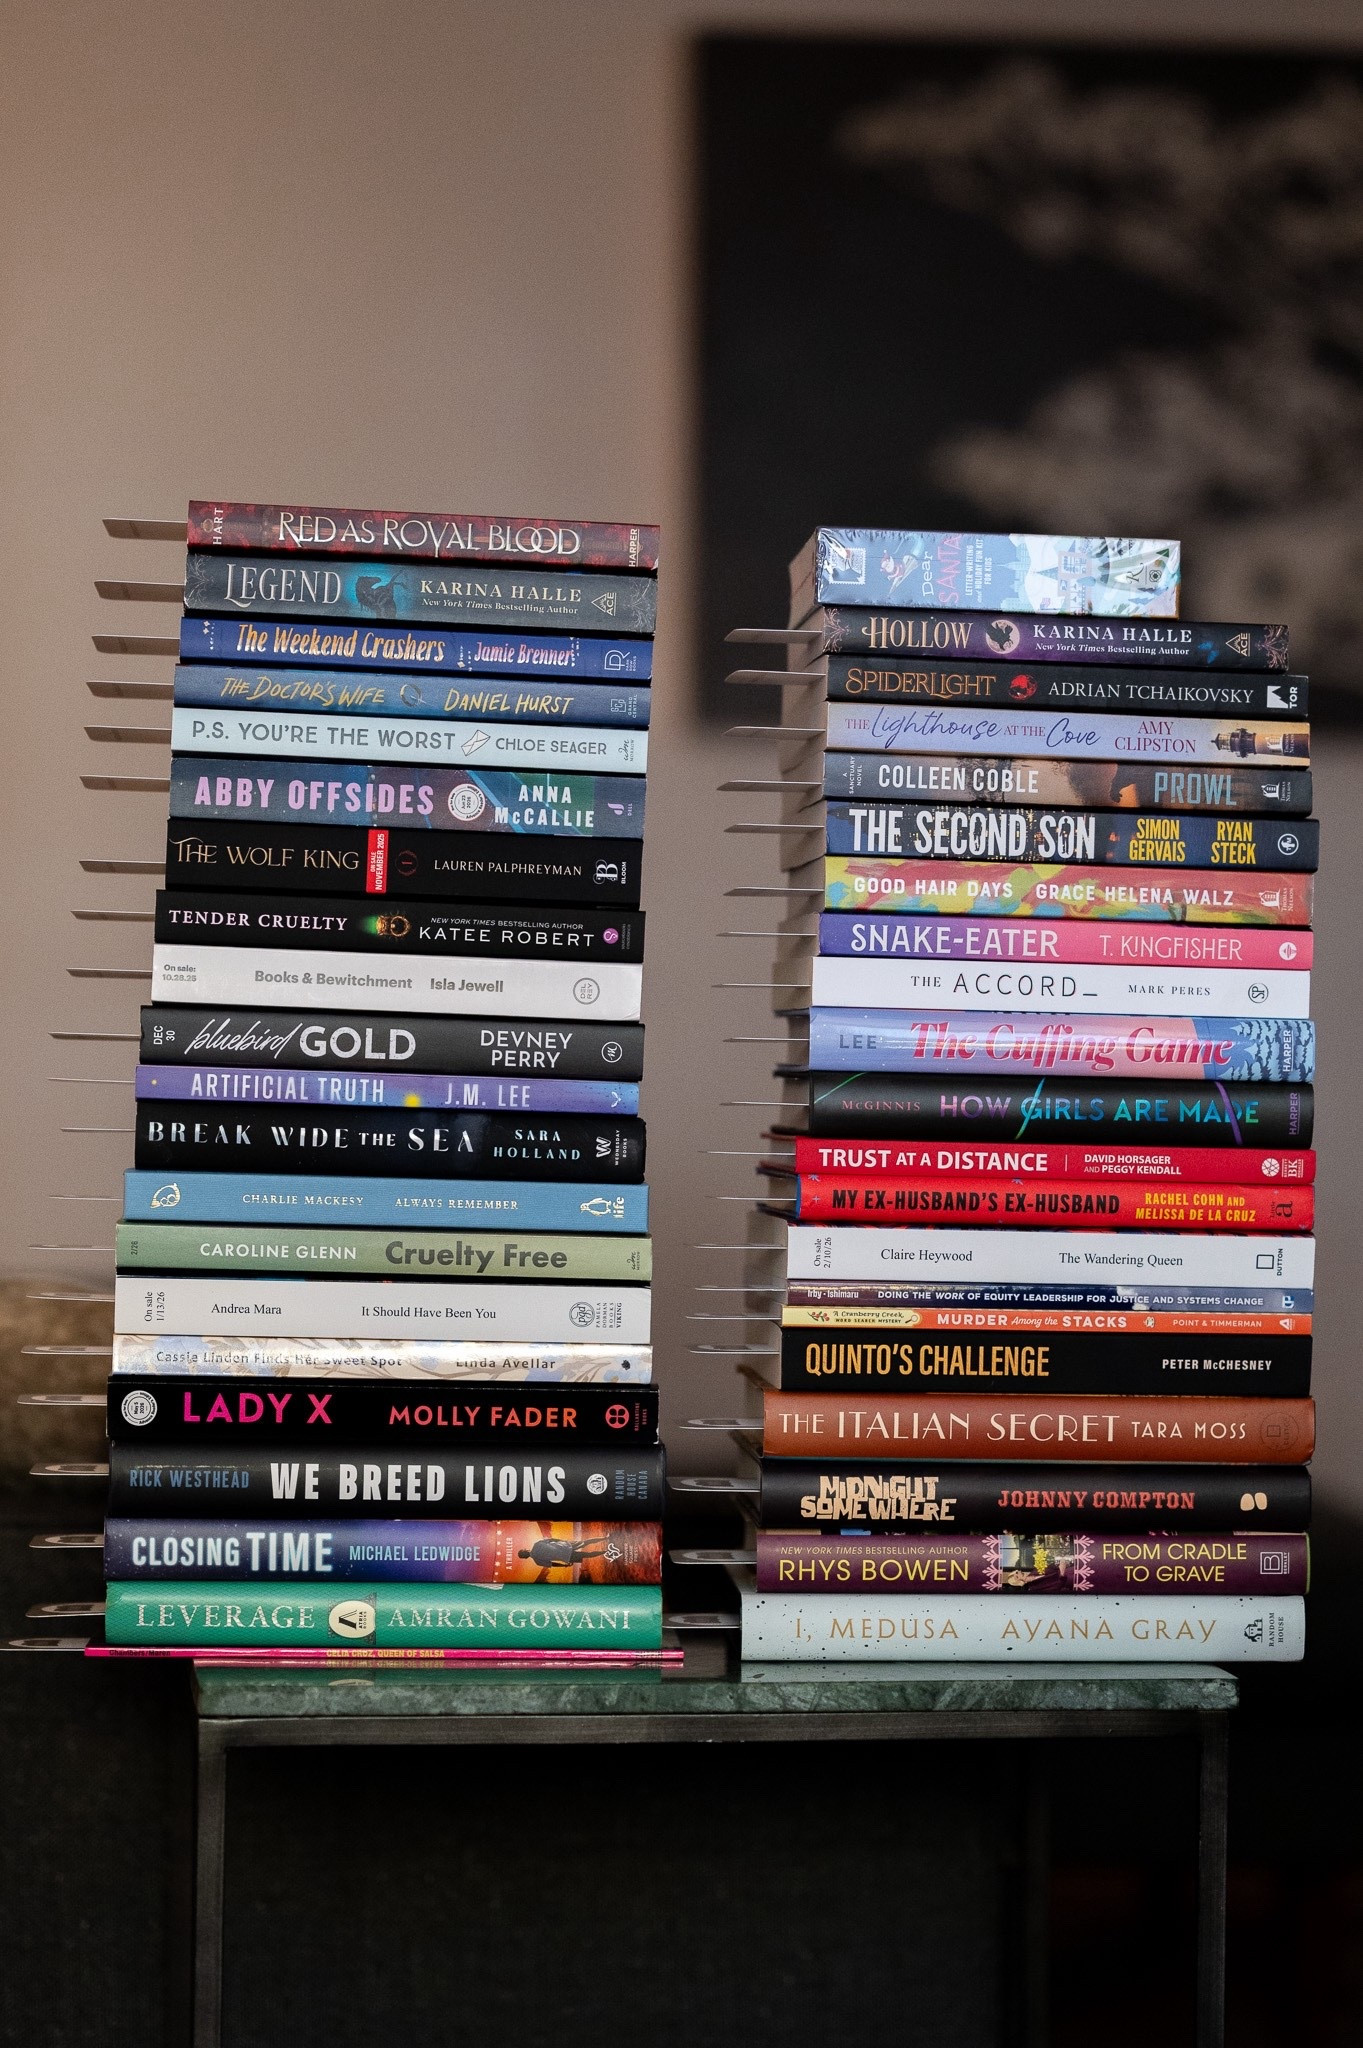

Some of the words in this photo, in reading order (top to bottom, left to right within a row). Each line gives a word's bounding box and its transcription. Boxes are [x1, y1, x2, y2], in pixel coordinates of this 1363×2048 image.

[212, 508, 224, 545] HART
[278, 512, 336, 547] RED
[341, 520, 376, 543] AS
[383, 518, 481, 558] ROYAL
[488, 524, 580, 554] BLOOD
[224, 563, 342, 608] LEGEND
[420, 580, 502, 598] KARINA
[511, 586, 581, 602] HALLE
[422, 598, 440, 606] New
[443, 600, 463, 608] York
[466, 600, 492, 610] Times
[495, 602, 544, 614] Bestselling
[547, 606, 578, 614] Author
[236, 624, 268, 652] The
[274, 627, 358, 656] Weekend
[362, 632, 446, 662] Crashers
[862, 616, 973, 648] HOLLOW
[474, 642, 514, 663] Jamie
[518, 644, 572, 666] Brenner
[1056, 644, 1076, 652] York
[1078, 644, 1105, 652] Times
[1108, 646, 1156, 656] Bestselling
[1158, 647, 1190, 655] Author
[846, 668, 996, 699] SPIDERLIGHT
[1048, 682, 1120, 698] ADRIAN
[1126, 684, 1254, 704] TCHAIKOVSKY
[192, 720, 229, 739] P.S.
[238, 722, 318, 744] YOU'RE
[327, 727, 368, 746] THE
[378, 730, 456, 750] WORST
[194, 776, 274, 808] ABBY
[288, 780, 434, 815] OFFSIDES
[1154, 772, 1236, 806] PROWL
[849, 808, 903, 852] THE
[915, 811, 1026, 857] SECOND
[1038, 816, 1095, 860] SON
[169, 837, 217, 864] THE
[226, 846, 294, 867] WOLF
[304, 850, 359, 870] KING
[854, 878, 905, 894] GOOD
[916, 880, 957, 896] HAIR
[968, 881, 1012, 897] DAYS
[1036, 884, 1094, 900] GRACE
[1106, 886, 1174, 904] HELENA
[1184, 890, 1234, 906] WALZ
[168, 910, 250, 926] TENDER
[258, 914, 348, 930] CRUELTY
[851, 924, 1060, 957] SNAKE-EATER
[255, 970, 298, 984] Books
[302, 974, 312, 984] &
[316, 974, 412, 989] Bewitchment
[910, 976, 941, 988] THE
[1128, 984, 1164, 994] MARK
[1171, 986, 1210, 996] PERES
[184, 1018, 303, 1059] bluebird
[300, 1026, 416, 1060] GOLD
[191, 1074, 308, 1100] ARTIFICIAL
[318, 1078, 384, 1102] TRUTH
[940, 1096, 1011, 1118] HOW
[1020, 1097, 1104, 1121] GIRLS
[1114, 1099, 1168, 1122] ARE
[1179, 1100, 1259, 1123] MADE
[148, 1121, 251, 1144] BREAK
[271, 1126, 348, 1148] WIDE
[358, 1132, 396, 1146] THE
[407, 1128, 474, 1152] SEA
[818, 1148, 891, 1168] TRUST
[896, 1152, 916, 1166] AT
[920, 1153, 932, 1166] A
[937, 1152, 1048, 1172] DISTANCE
[1084, 1154, 1115, 1164] DAVID
[1117, 1156, 1171, 1164] HORSAGER
[1102, 1165, 1134, 1174] PEGGY
[1137, 1166, 1182, 1175] KENDALL
[242, 1194, 298, 1204] CHARLIE
[304, 1196, 364, 1206] MACKESY
[394, 1198, 443, 1208] ALWAYS
[448, 1200, 518, 1210] REMEMBER
[832, 1190, 858, 1208] MY
[864, 1190, 998, 1212] EX-HUSBAND'S
[1005, 1193, 1120, 1214] EX-HUSBAND
[1145, 1193, 1188, 1206] RACHEL
[1193, 1194, 1224, 1206] COHN
[1227, 1197, 1245, 1206] AND
[1135, 1208, 1184, 1220] MELISSA
[1190, 1210, 1204, 1220] DE
[1208, 1210, 1222, 1221] LA
[1226, 1210, 1256, 1222] CRUZ
[200, 1244, 289, 1258] CAROLINE
[296, 1246, 356, 1260] GLENN
[385, 1241, 494, 1273] Cruelty
[504, 1244, 568, 1268] Free
[880, 1249, 916, 1260] Claire
[919, 1250, 972, 1264] Heywood
[1059, 1253, 1080, 1264] The
[1084, 1254, 1144, 1266] Wandering
[1147, 1255, 1183, 1266] Queen
[211, 1304, 250, 1314] Andrea
[254, 1304, 282, 1315] Mara
[878, 1291, 909, 1299] DOING
[936, 1292, 965, 1300] WORK
[968, 1292, 981, 1300] OF
[984, 1293, 1020, 1301] EQUITY
[1024, 1294, 1084, 1302] LEADERSHIP
[1087, 1294, 1106, 1303] FOR
[1110, 1296, 1149, 1304] JUSTICE
[1153, 1296, 1173, 1304] AND
[1177, 1296, 1220, 1304] SYSTEMS
[1224, 1297, 1264, 1306] CHANGE
[362, 1306, 372, 1316] It
[373, 1306, 410, 1318] Should
[414, 1308, 442, 1318] Have
[446, 1308, 472, 1318] Been
[475, 1308, 496, 1318] You
[938, 1314, 1008, 1326] MURDER
[1011, 1316, 1042, 1328] Among
[1044, 1317, 1058, 1326] the
[1062, 1317, 1127, 1328] STACKS
[1210, 1320, 1262, 1328] TIMMERMAN
[806, 1343, 913, 1376] QUINTO'S
[920, 1344, 1049, 1376] CHALLENGE
[1162, 1359, 1198, 1370] PETER
[1204, 1360, 1272, 1370] McCHESNEY
[184, 1392, 292, 1422] LADY
[306, 1394, 332, 1424] X
[778, 1414, 824, 1434] THE
[838, 1412, 969, 1440] ITALIAN
[986, 1414, 1120, 1442] SECRET
[270, 1463, 319, 1500] WE
[339, 1464, 446, 1502] BREED
[465, 1465, 566, 1504] LIONS
[998, 1491, 1088, 1508] JOHNNY
[1092, 1492, 1194, 1509] COMPTON
[132, 1537, 240, 1566] CLOSING
[246, 1532, 333, 1572] TIME
[1102, 1544, 1161, 1560] FROM
[1168, 1544, 1247, 1560] CRADLE
[780, 1560, 850, 1581] RHYS
[862, 1560, 968, 1581] BOWEN
[1124, 1566, 1149, 1582] TO
[1156, 1566, 1224, 1582] GRAVE
[136, 1604, 315, 1629] LEVERAGE
[796, 1618, 812, 1642] I,
[830, 1618, 959, 1638] MEDUSA
